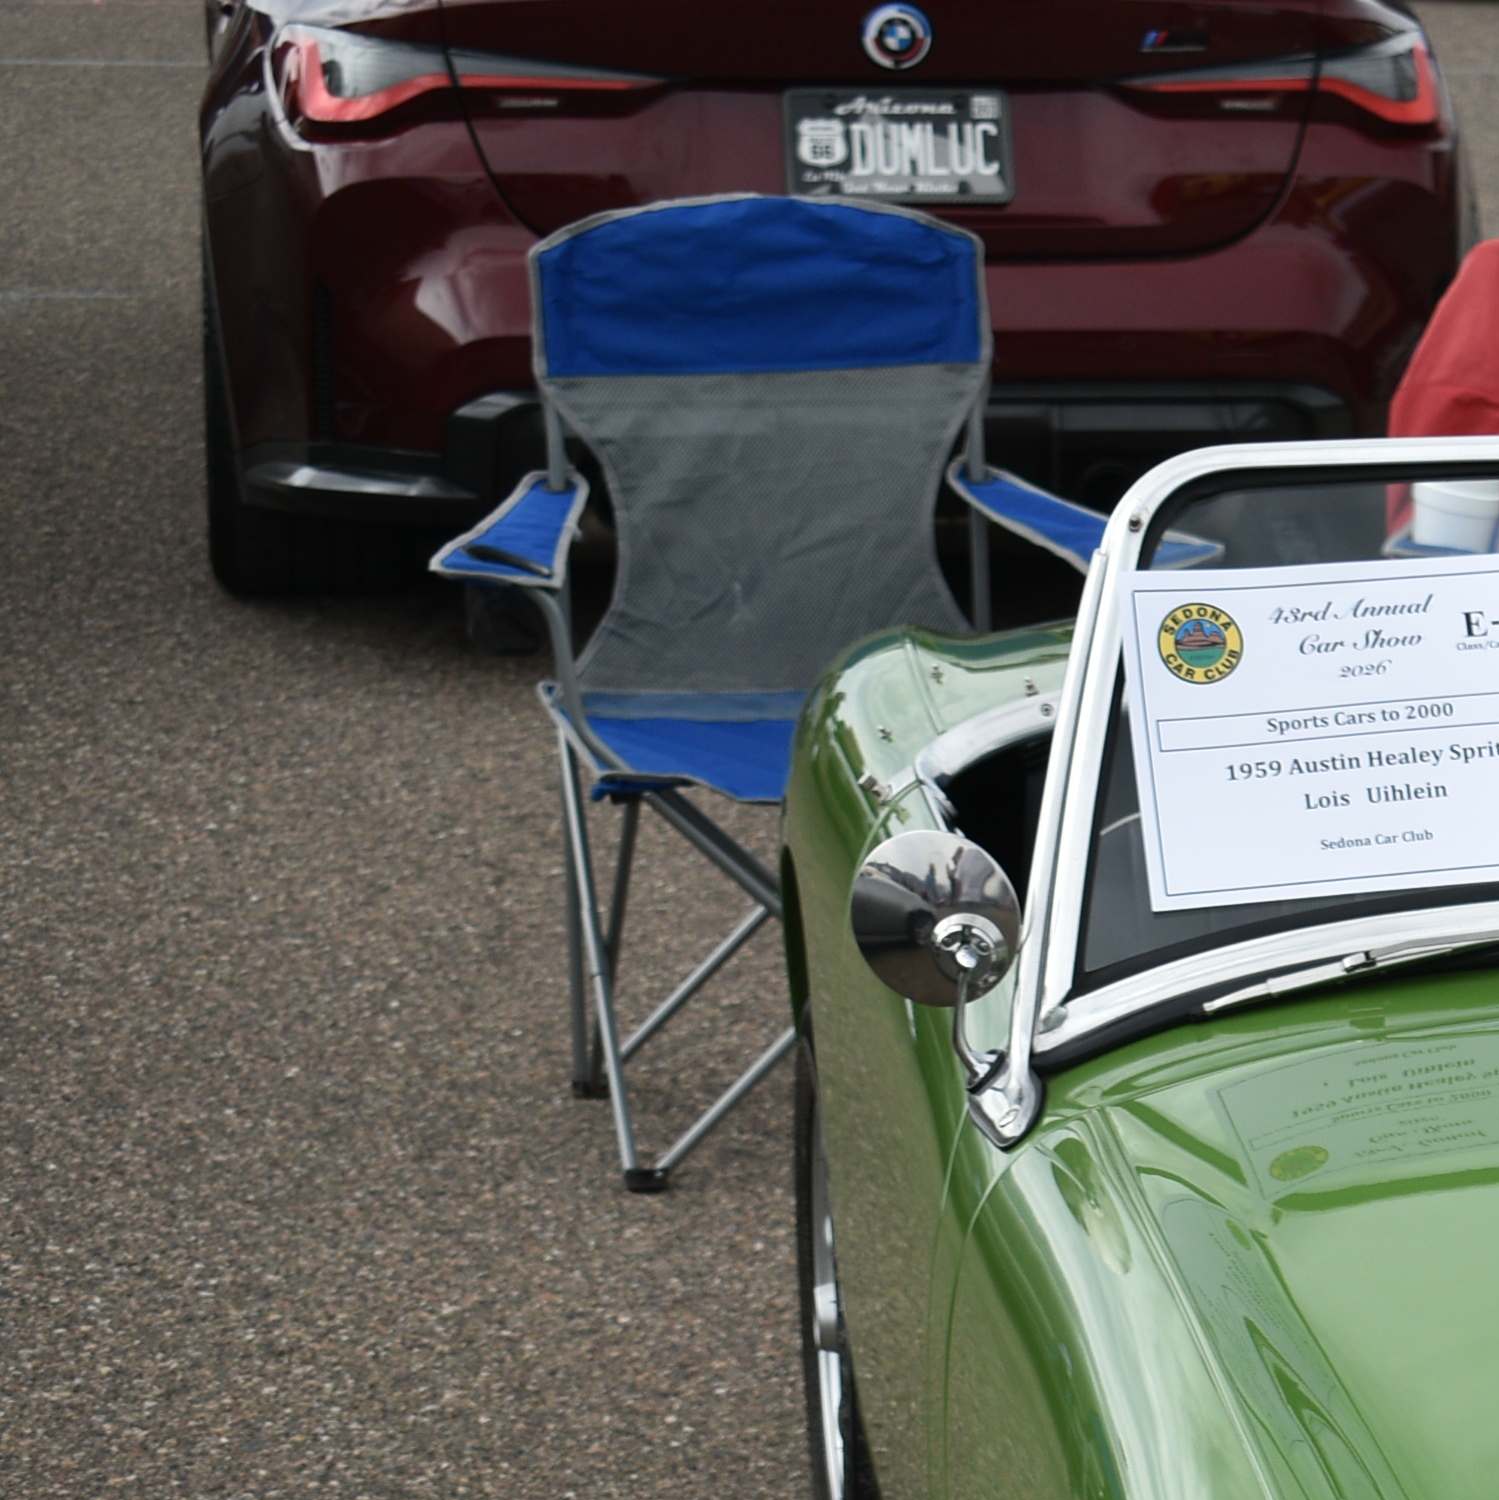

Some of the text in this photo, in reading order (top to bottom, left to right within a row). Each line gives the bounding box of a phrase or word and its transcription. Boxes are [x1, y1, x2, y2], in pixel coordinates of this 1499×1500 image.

[834, 95, 957, 116] Arizona
[850, 121, 1001, 177] DUMLUC
[1163, 606, 1233, 636] SEDONA
[1268, 594, 1434, 624] 43rd Annual
[1300, 629, 1423, 656] Car Show
[1165, 649, 1240, 680] CAR CLUB
[1339, 659, 1393, 678] 2026
[1267, 702, 1454, 735] Sports Cars to 2000
[1226, 760, 1283, 781] 1959
[1288, 753, 1361, 776] Austin
[1367, 748, 1443, 767] Healey
[1305, 782, 1448, 810] Lois Uihlein
[1320, 829, 1433, 850] Sedona Car Club
